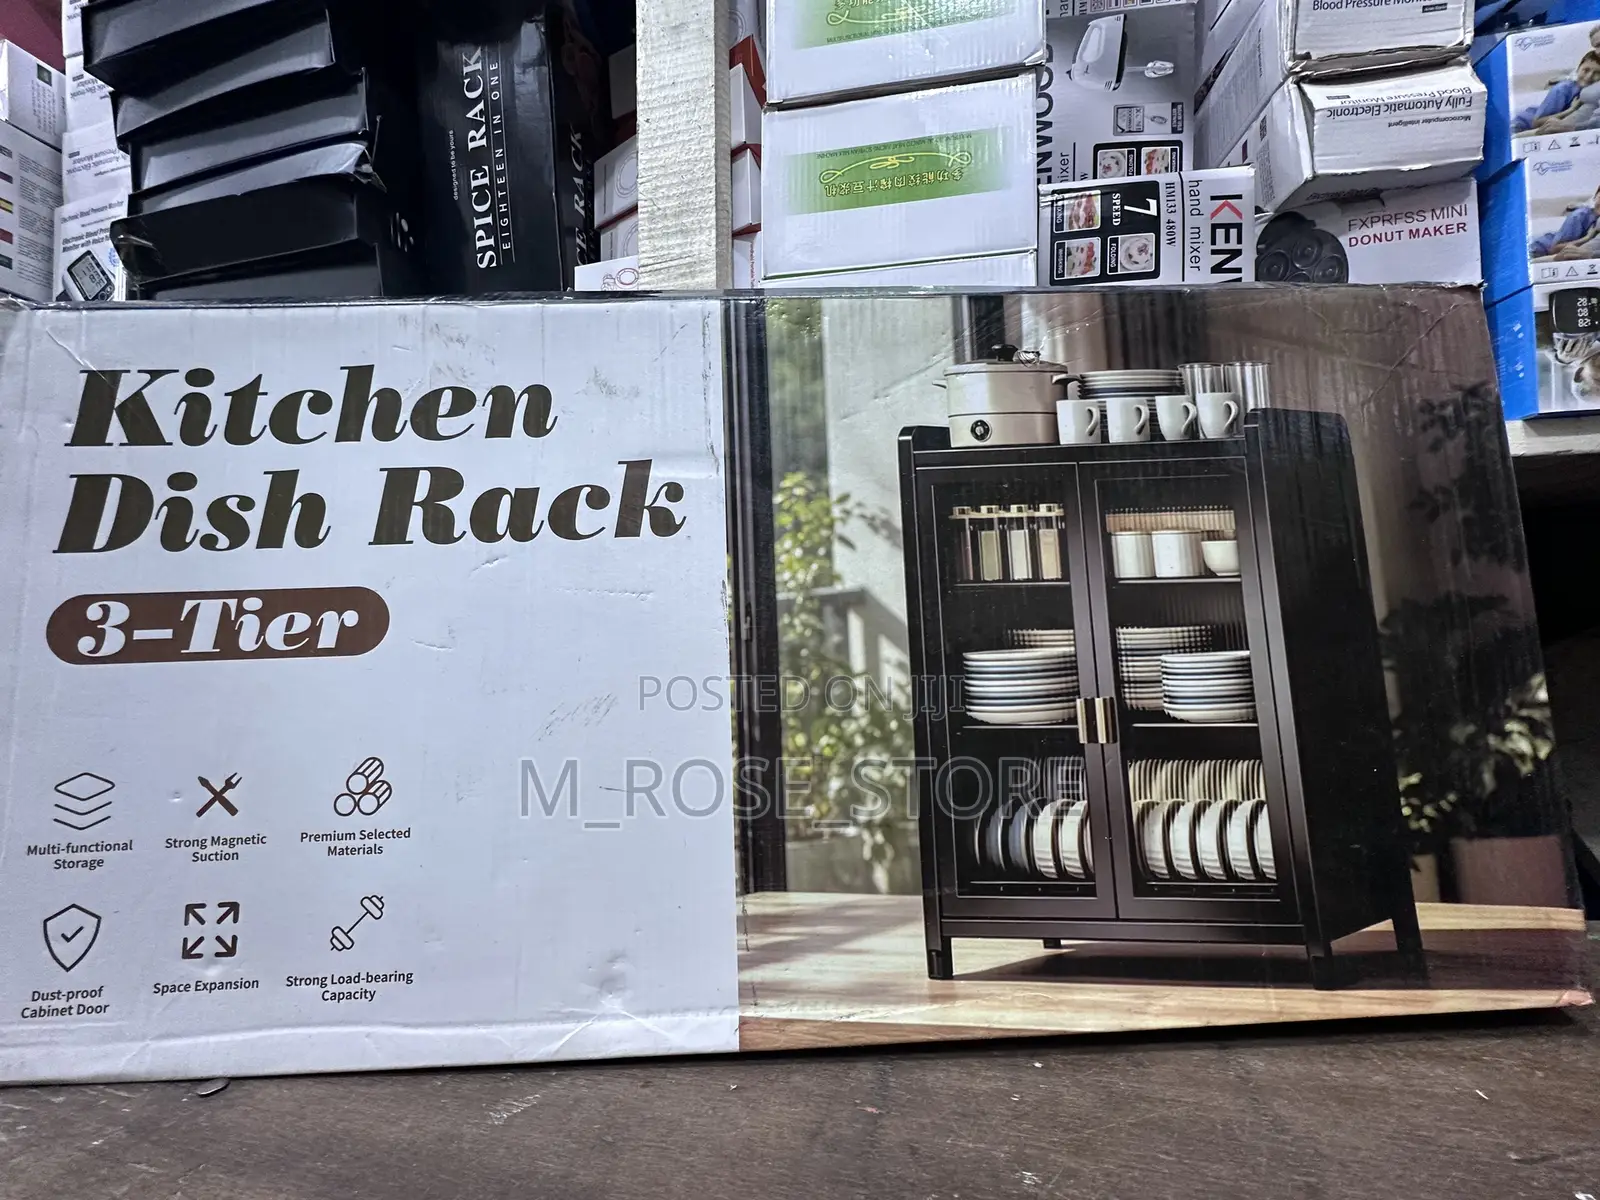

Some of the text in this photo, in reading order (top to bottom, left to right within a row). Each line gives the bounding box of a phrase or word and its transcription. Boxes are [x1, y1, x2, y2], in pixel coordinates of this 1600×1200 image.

[1312, 0, 1344, 10] Blood
[1345, 0, 1393, 8] Pressure
[1340, 95, 1385, 105] Monitor
[1386, 91, 1436, 102] Pressure
[1437, 86, 1472, 99] Blood
[1326, 96, 1473, 120] Fully Automatic Electronic
[1421, 115, 1472, 125] Microcomputer
[462, 47, 497, 269] SPICE RACK
[489, 62, 511, 250] EIGHTEEN IN ONE
[1112, 193, 1121, 226] SPEED
[1124, 197, 1158, 217] 7
[1165, 182, 1176, 247] HM133 480W
[1431, 203, 1468, 220] MINI
[1188, 180, 1205, 272] hand mixer
[1348, 222, 1467, 247] DONUT MAKER
[1210, 194, 1243, 283] KEN
[1109, 243, 1117, 268] FOLDING
[63, 364, 557, 447] Kitchen
[53, 459, 687, 554] Dish Rack
[76, 597, 359, 658] 3-Tier
[165, 833, 267, 851] Strong Magnetic
[300, 827, 411, 843] Premium Selected
[26, 839, 133, 856] Multi-functional
[191, 849, 239, 862] Suction
[327, 843, 384, 857] Materials
[53, 857, 104, 870] Storage
[153, 977, 260, 995] Space Expansion
[286, 970, 414, 988] Strong Load-bearing
[31, 986, 103, 1003] Dust-proof
[321, 987, 376, 1003] Capacity
[21, 1002, 110, 1019] Cabinet Door
